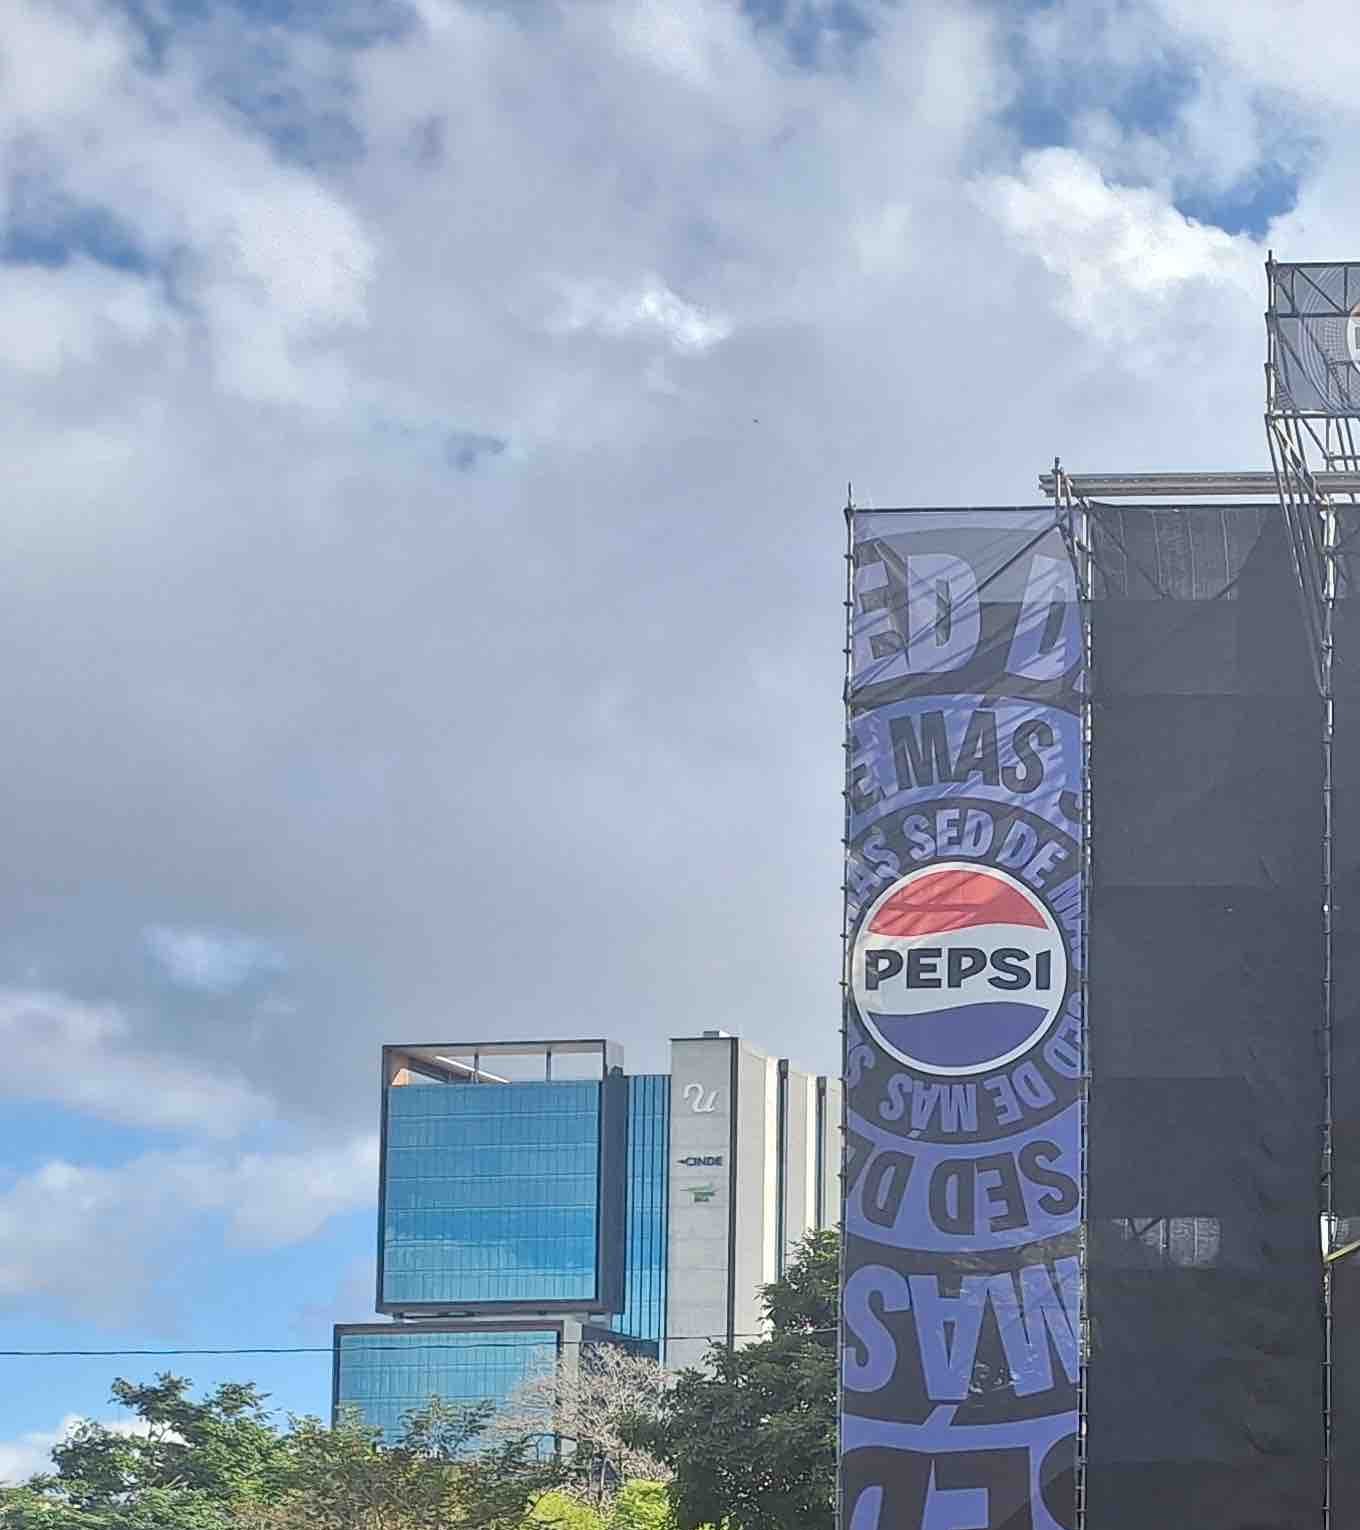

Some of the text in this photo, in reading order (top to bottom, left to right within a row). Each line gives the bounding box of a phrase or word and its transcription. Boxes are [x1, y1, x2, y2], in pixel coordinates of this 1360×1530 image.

[903, 808, 994, 861] SED
[995, 829, 1071, 889] DE
[864, 947, 1052, 991] PEPSI
[929, 1140, 1080, 1236] SED
